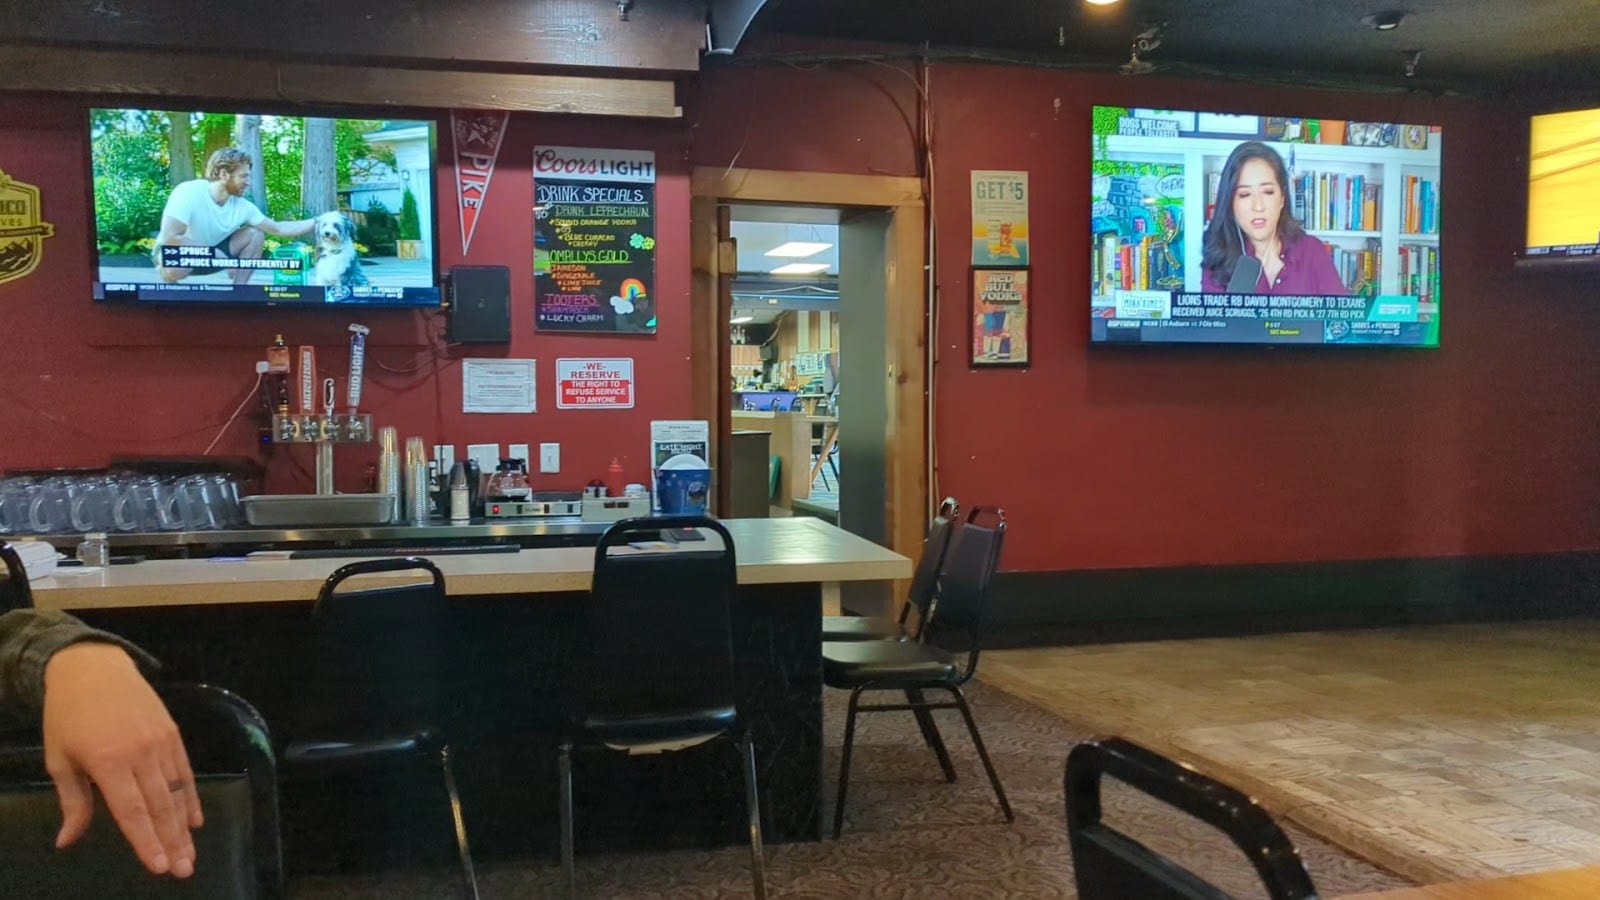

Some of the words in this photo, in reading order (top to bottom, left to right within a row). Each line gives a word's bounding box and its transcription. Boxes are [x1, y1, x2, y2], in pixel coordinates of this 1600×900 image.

[1141, 118, 1179, 130] WELCOME
[535, 149, 598, 174] Coors
[600, 159, 653, 177] LIGHT
[460, 151, 494, 209] PIKE
[537, 185, 580, 201] DRINK
[582, 187, 644, 202] SPECIALS
[976, 181, 1006, 200] GET
[1008, 181, 1024, 200] $5
[555, 205, 585, 217] DRUNK
[589, 206, 650, 217] LEPRECHAUN
[179, 246, 213, 256] SPRUCE.
[598, 250, 629, 262] GOLD
[179, 258, 210, 267] SPRUCE
[212, 259, 239, 268] WORKS
[240, 260, 288, 268] DIFFERENTLY
[544, 293, 598, 306] TOOTERS
[1177, 294, 1202, 306] LIONS
[1202, 295, 1229, 306] TRADE
[1230, 296, 1242, 306] RB
[1244, 296, 1268, 307] DAVID
[1270, 296, 1325, 308] MONTGOMERY
[1326, 297, 1336, 308] TO
[1337, 298, 1366, 309] TEXANS
[1172, 307, 1205, 316] RECEIVED
[1206, 308, 1224, 317] JUICE
[1270, 309, 1282, 318] 4TH
[1282, 309, 1292, 318] RD
[1294, 309, 1308, 318] PICK
[1327, 310, 1339, 318] 7TH
[1340, 310, 1350, 318] RD
[1350, 310, 1365, 319] PICK
[1378, 304, 1412, 314] ESPN
